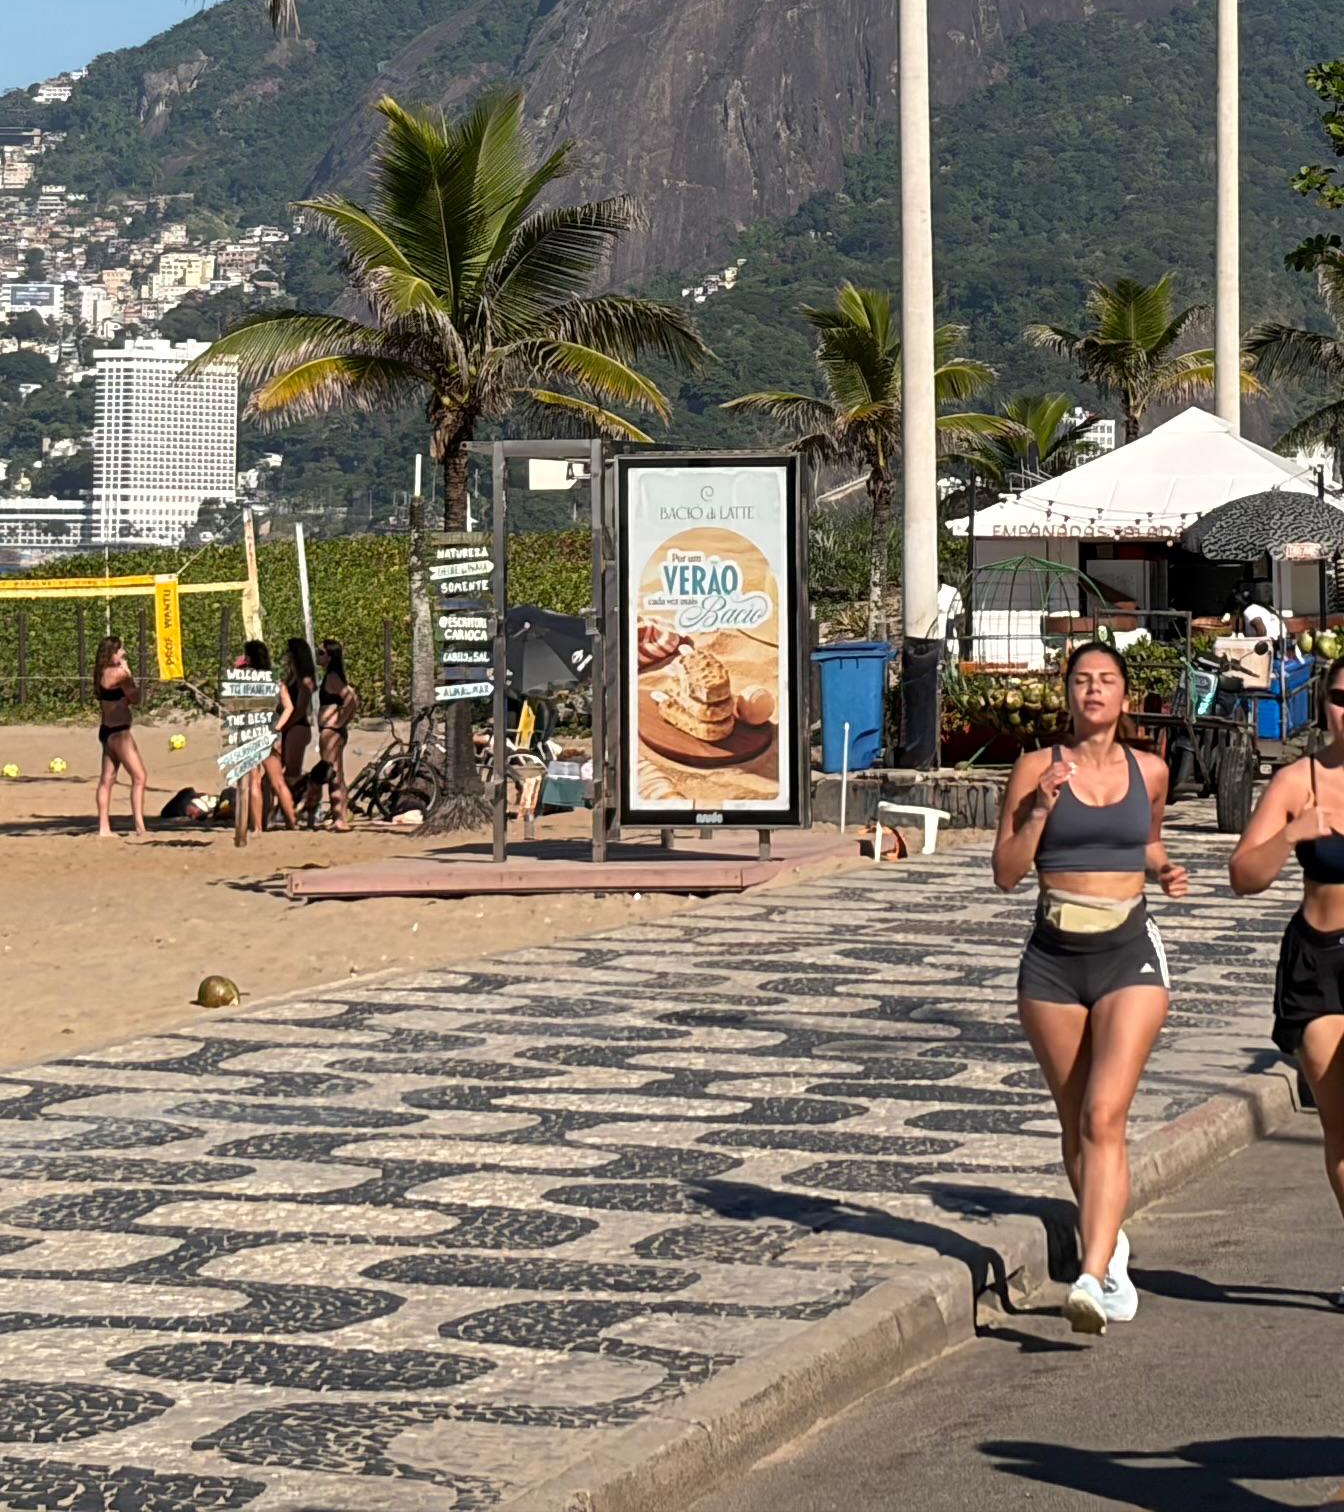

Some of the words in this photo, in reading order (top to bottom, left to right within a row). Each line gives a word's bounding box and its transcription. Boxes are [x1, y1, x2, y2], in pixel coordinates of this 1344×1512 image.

[660, 506, 703, 520] BACIO
[719, 505, 754, 520] LATTE
[663, 560, 738, 596] VERÃO
[441, 580, 489, 594] SOMENTE
[444, 628, 488, 642] CARIOCA
[226, 669, 273, 682] WELCOME
[227, 714, 246, 727] THE
[247, 712, 273, 725] BEST
[228, 732, 238, 745] OF
